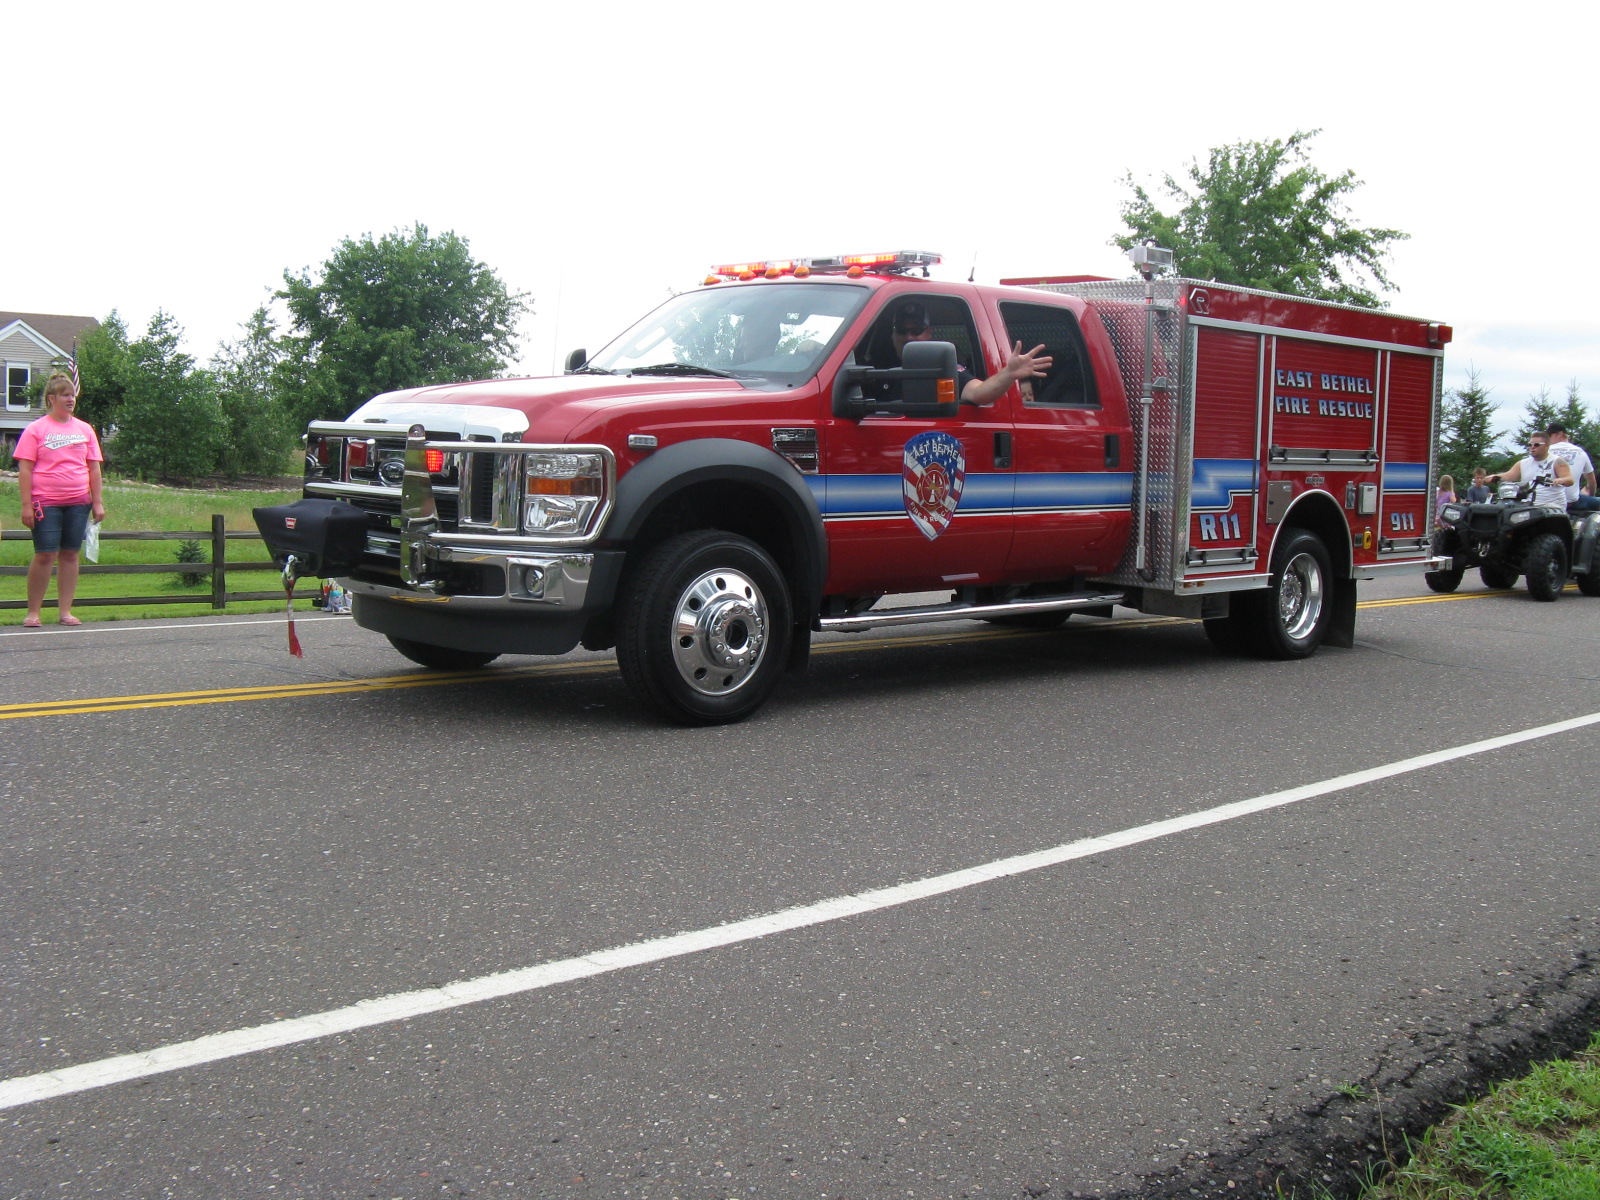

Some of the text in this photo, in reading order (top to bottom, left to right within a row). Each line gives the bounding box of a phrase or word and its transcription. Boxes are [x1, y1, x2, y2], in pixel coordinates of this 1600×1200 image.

[1276, 369, 1373, 394] EAST BETHEL
[1275, 396, 1373, 419] FIRE RESCUE
[908, 442, 961, 463] EAST BETHEL
[1199, 512, 1242, 541] R11
[1390, 511, 1415, 531] 911
